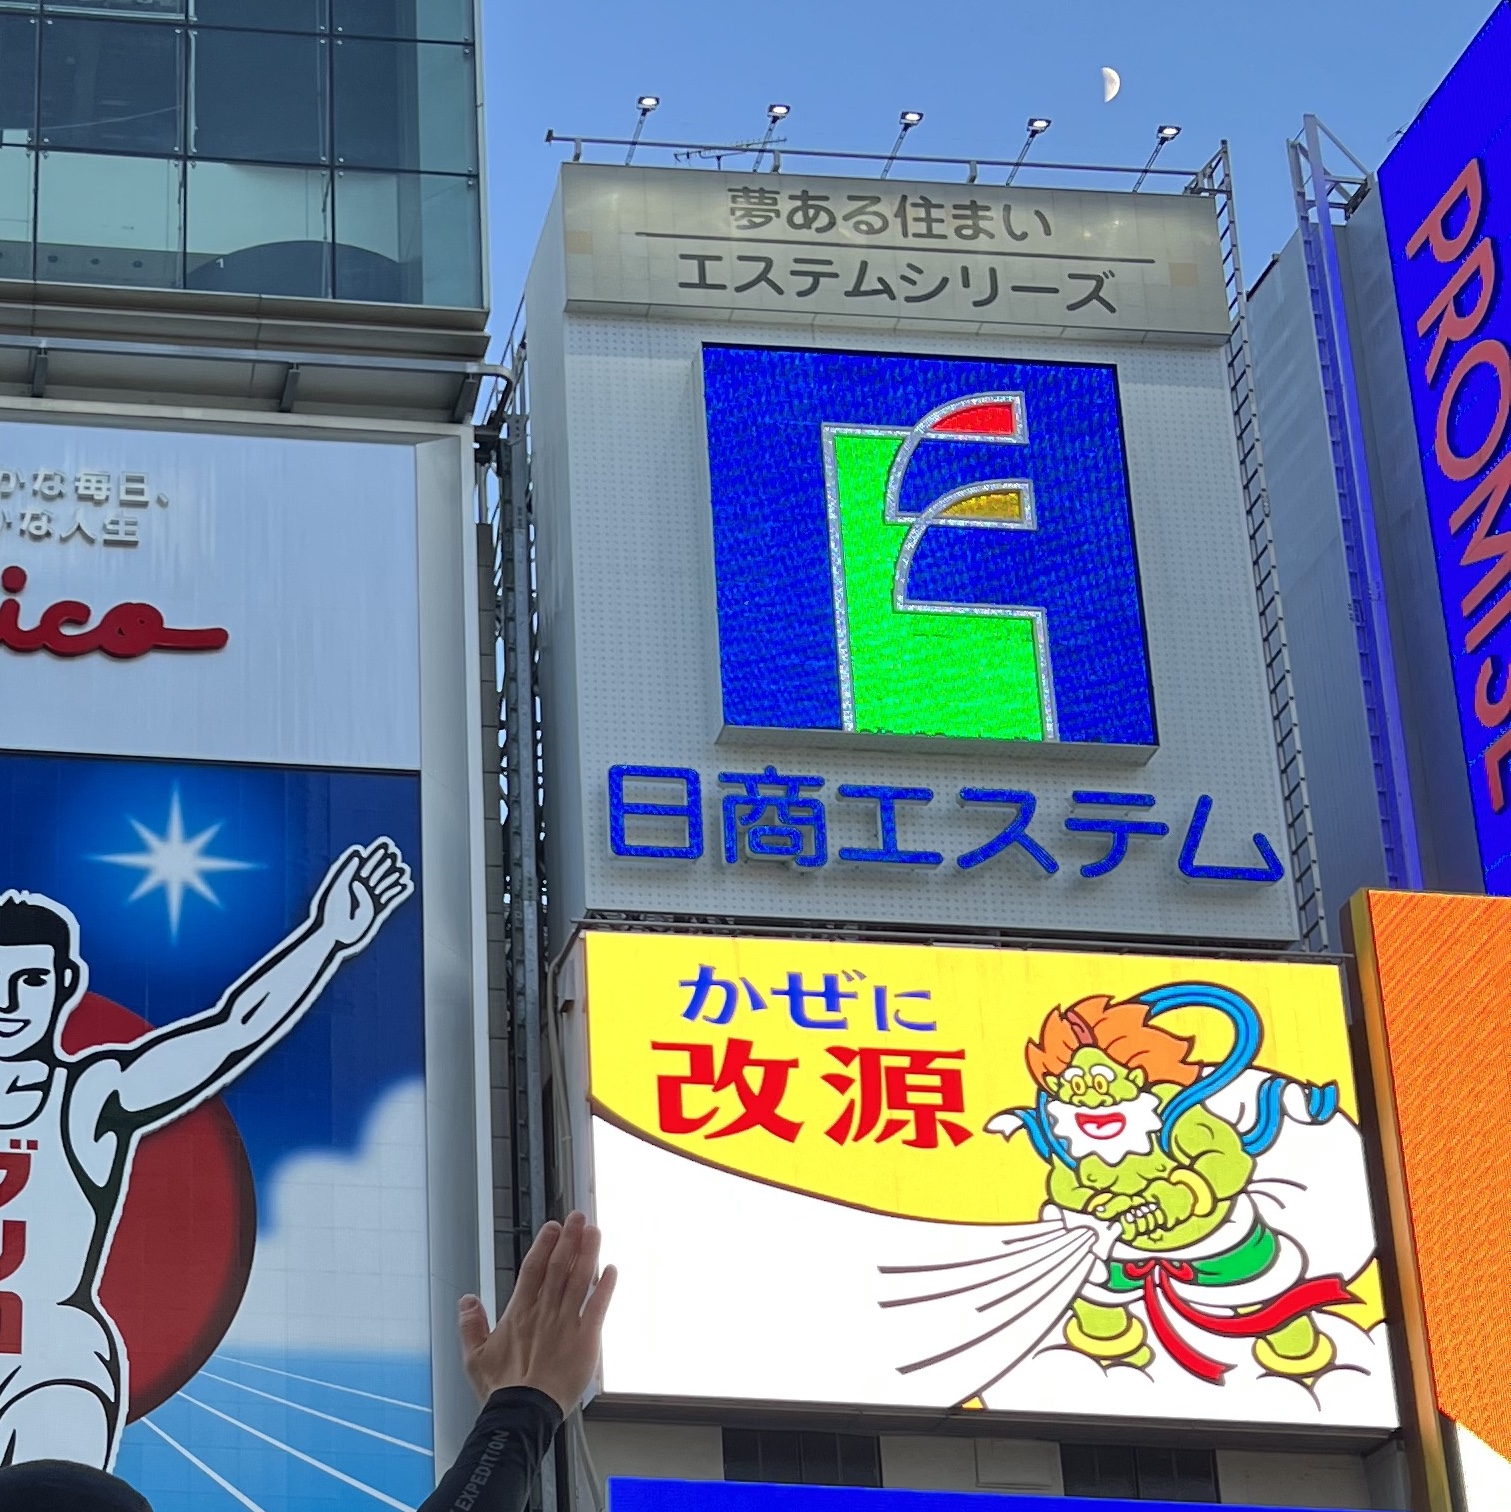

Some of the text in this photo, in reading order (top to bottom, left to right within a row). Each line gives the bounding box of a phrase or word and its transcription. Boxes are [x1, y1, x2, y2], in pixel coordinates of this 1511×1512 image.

[726, 186, 1054, 242] 夢ある住まい
[677, 252, 1119, 315] エステムシリーズ
[607, 764, 1286, 884] 日商エステム
[677, 963, 939, 1034] かぜに
[649, 1038, 974, 1151] 改源
[454, 1429, 511, 1512] EXPEDITION
